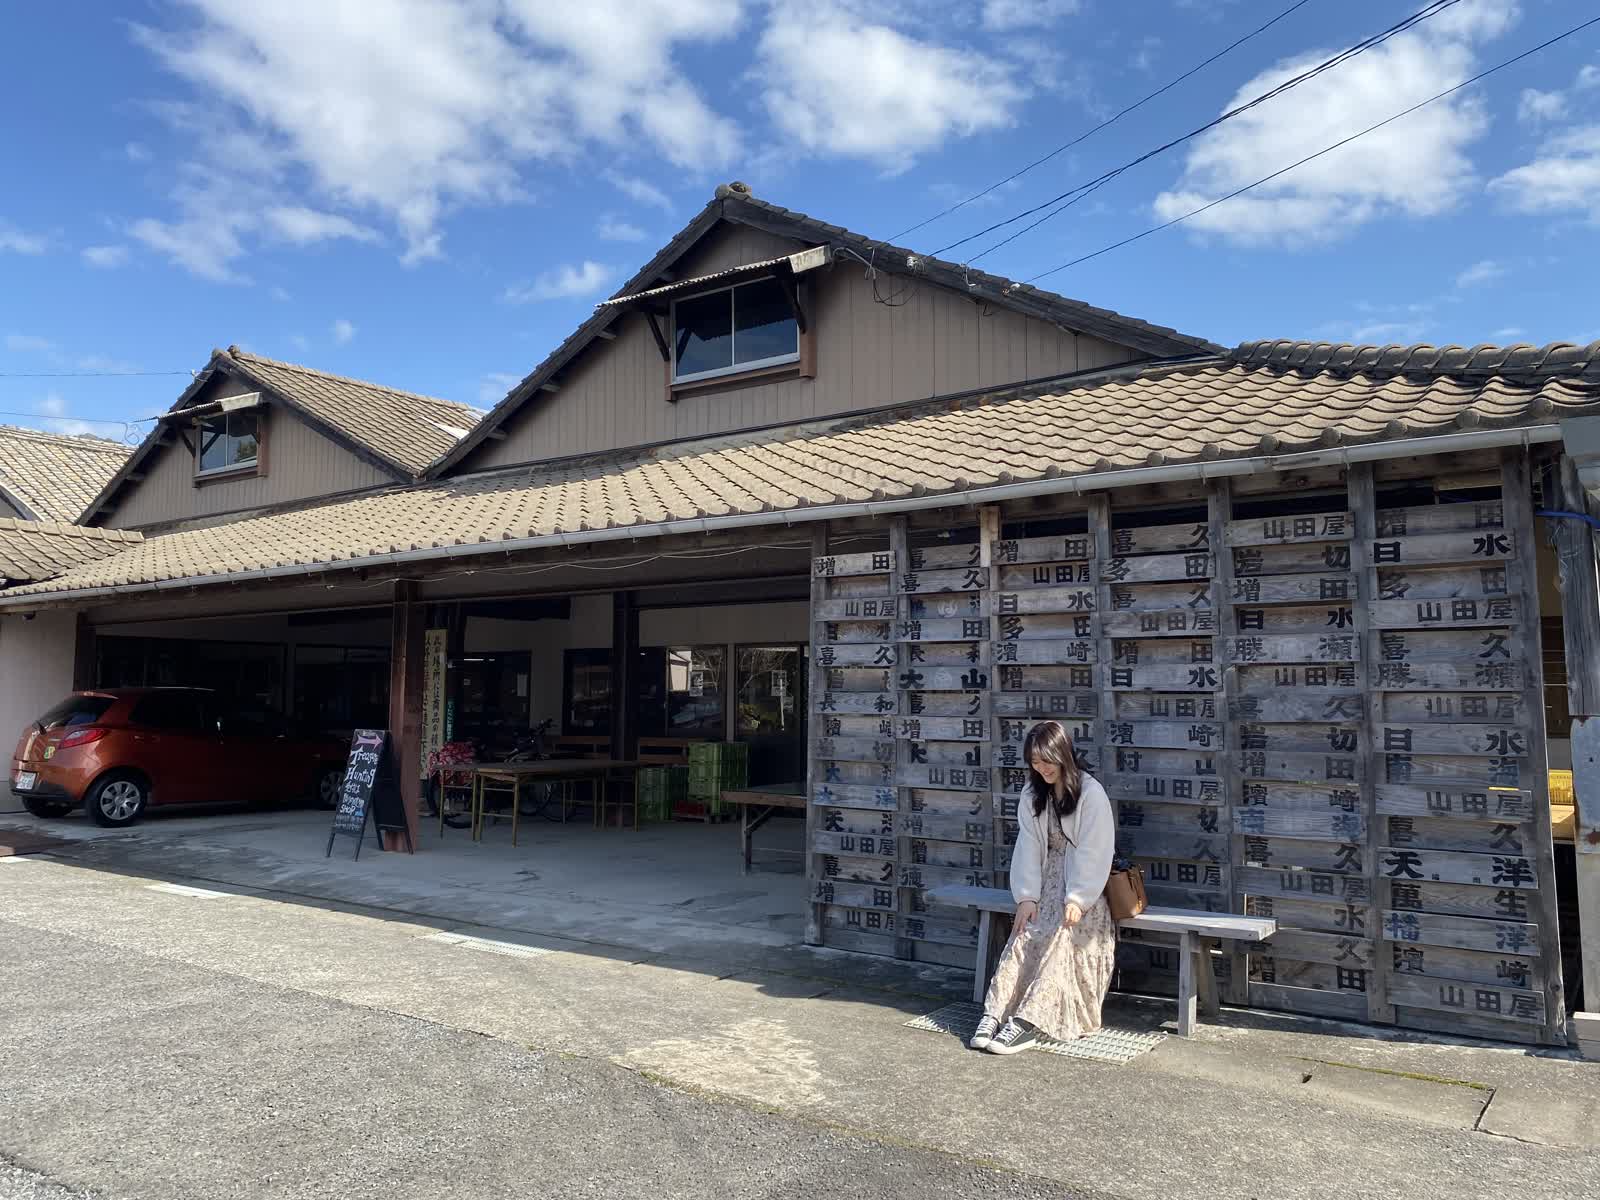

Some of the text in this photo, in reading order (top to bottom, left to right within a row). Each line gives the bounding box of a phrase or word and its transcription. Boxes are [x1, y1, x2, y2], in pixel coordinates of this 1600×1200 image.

[1263, 515, 1345, 539] 山田屋
[997, 538, 1089, 563] 増田
[1373, 534, 1512, 564] 日水
[818, 553, 890, 576] 増田
[1033, 563, 1090, 585] 山田屋
[1105, 553, 1209, 581] 多田
[901, 569, 985, 592] 喜久
[1231, 577, 1349, 602] 増田
[845, 600, 896, 618] 山田屋
[999, 590, 1095, 612] 日水
[1417, 599, 1513, 622] 山田屋
[900, 619, 983, 641] 増田
[1140, 610, 1215, 632] 山田屋
[819, 646, 895, 666] 喜久
[1382, 632, 1511, 661] 喜久
[899, 667, 988, 690] 大山
[1111, 666, 1218, 689] 日水
[1274, 666, 1356, 687] 山田屋
[1150, 698, 1216, 718] 山田屋
[1426, 696, 1515, 719] 山田屋
[901, 718, 984, 740] 増田
[1384, 727, 1527, 756] 日水
[343, 764, 377, 787] Hunting
[1240, 750, 1354, 781] 増田
[928, 767, 989, 789] 山田屋
[1145, 777, 1221, 802] 山田屋
[1426, 790, 1523, 816] 山田屋
[841, 836, 895, 857] 山田屋
[1150, 861, 1221, 886] 山田屋
[1384, 850, 1535, 888] 天洋
[815, 881, 892, 909] 増田
[1438, 985, 1541, 1023] 山田屋
